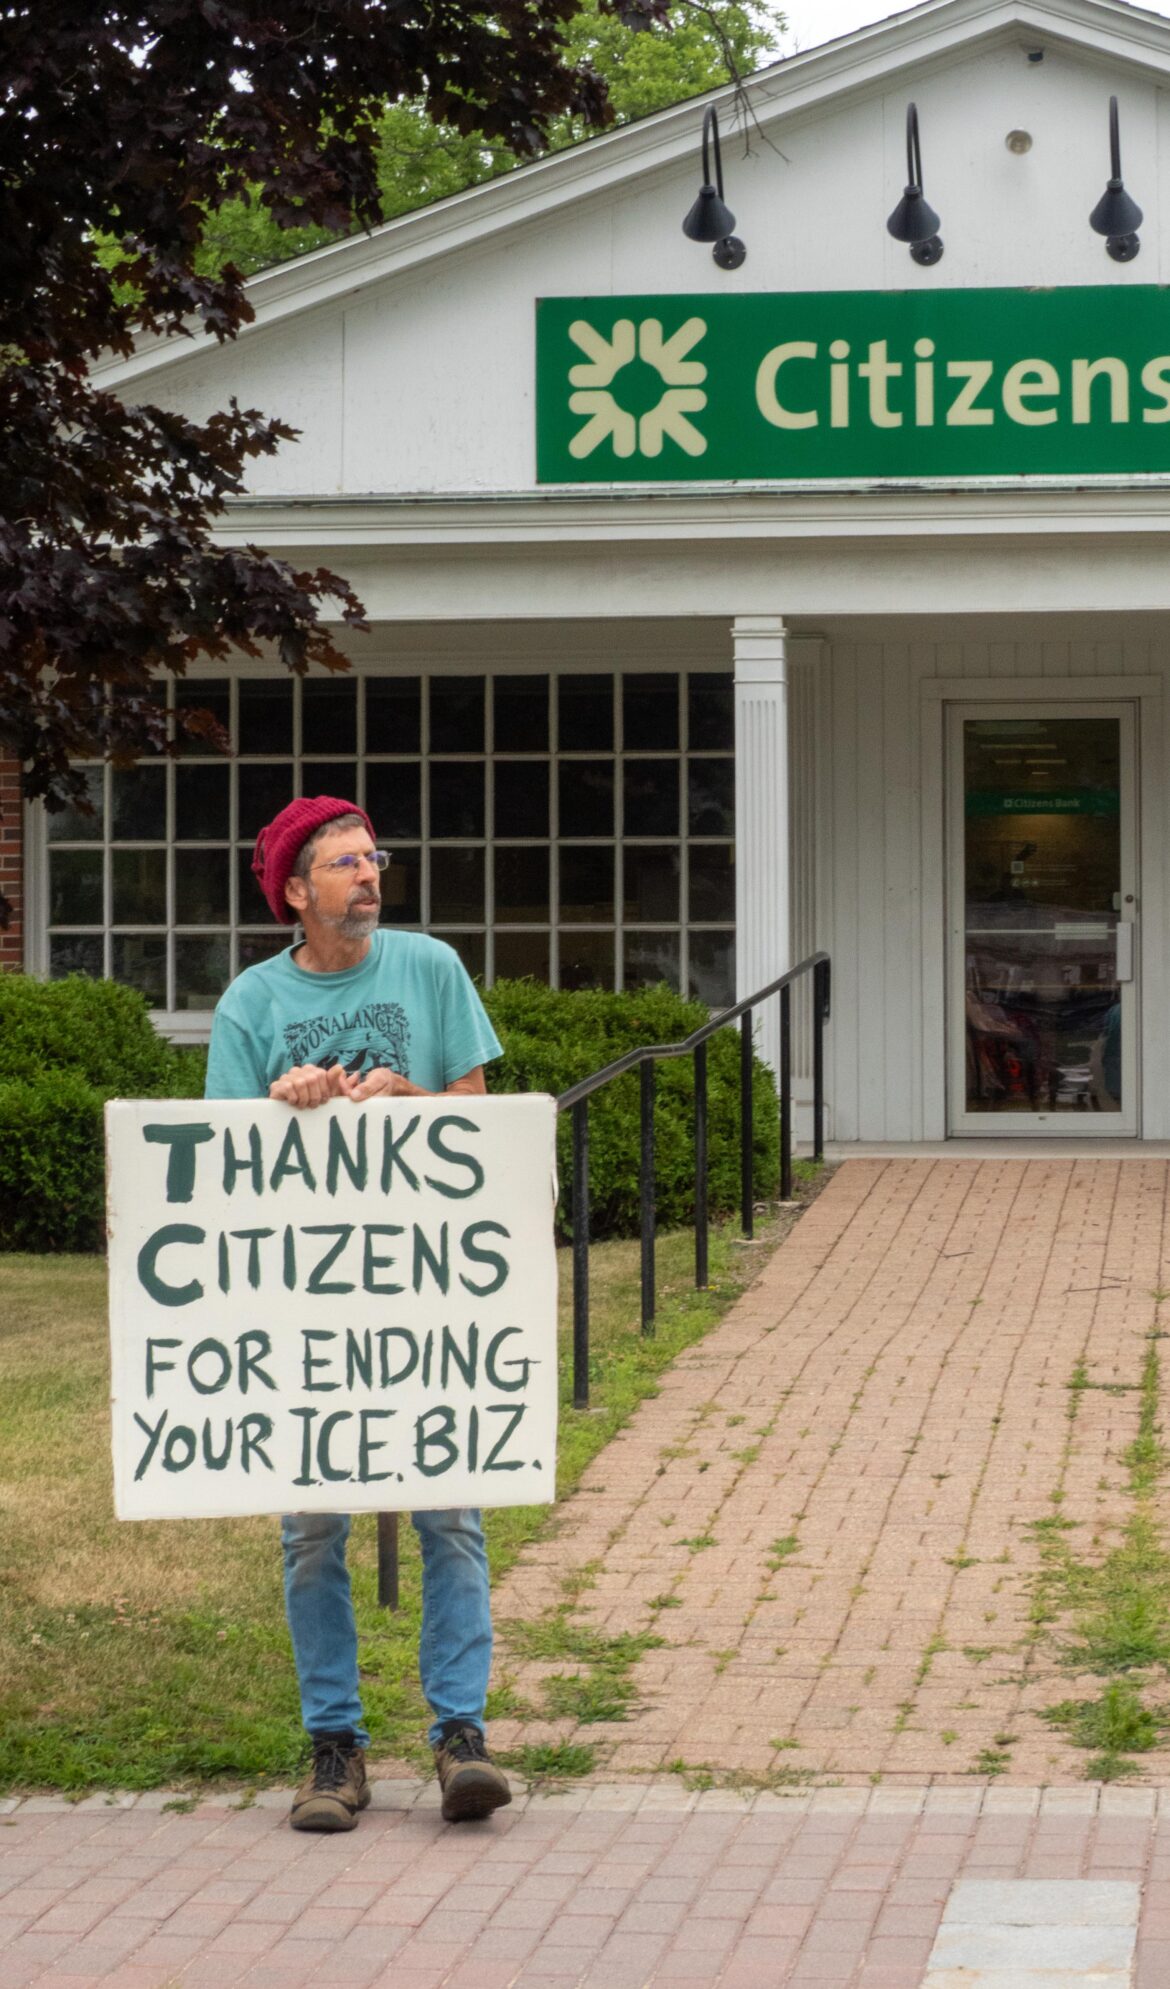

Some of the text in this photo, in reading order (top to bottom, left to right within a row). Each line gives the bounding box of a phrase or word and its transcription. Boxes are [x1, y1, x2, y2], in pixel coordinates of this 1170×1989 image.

[756, 338, 1170, 428] Citizens
[1014, 797, 1081, 808] Citizens Bank
[143, 1114, 484, 1203] THANKS
[138, 1221, 510, 1307] CITIZENS
[146, 1322, 541, 1399] FOR ENDING
[134, 1410, 274, 1482] YOUR
[413, 1404, 541, 1477] BIZ.
